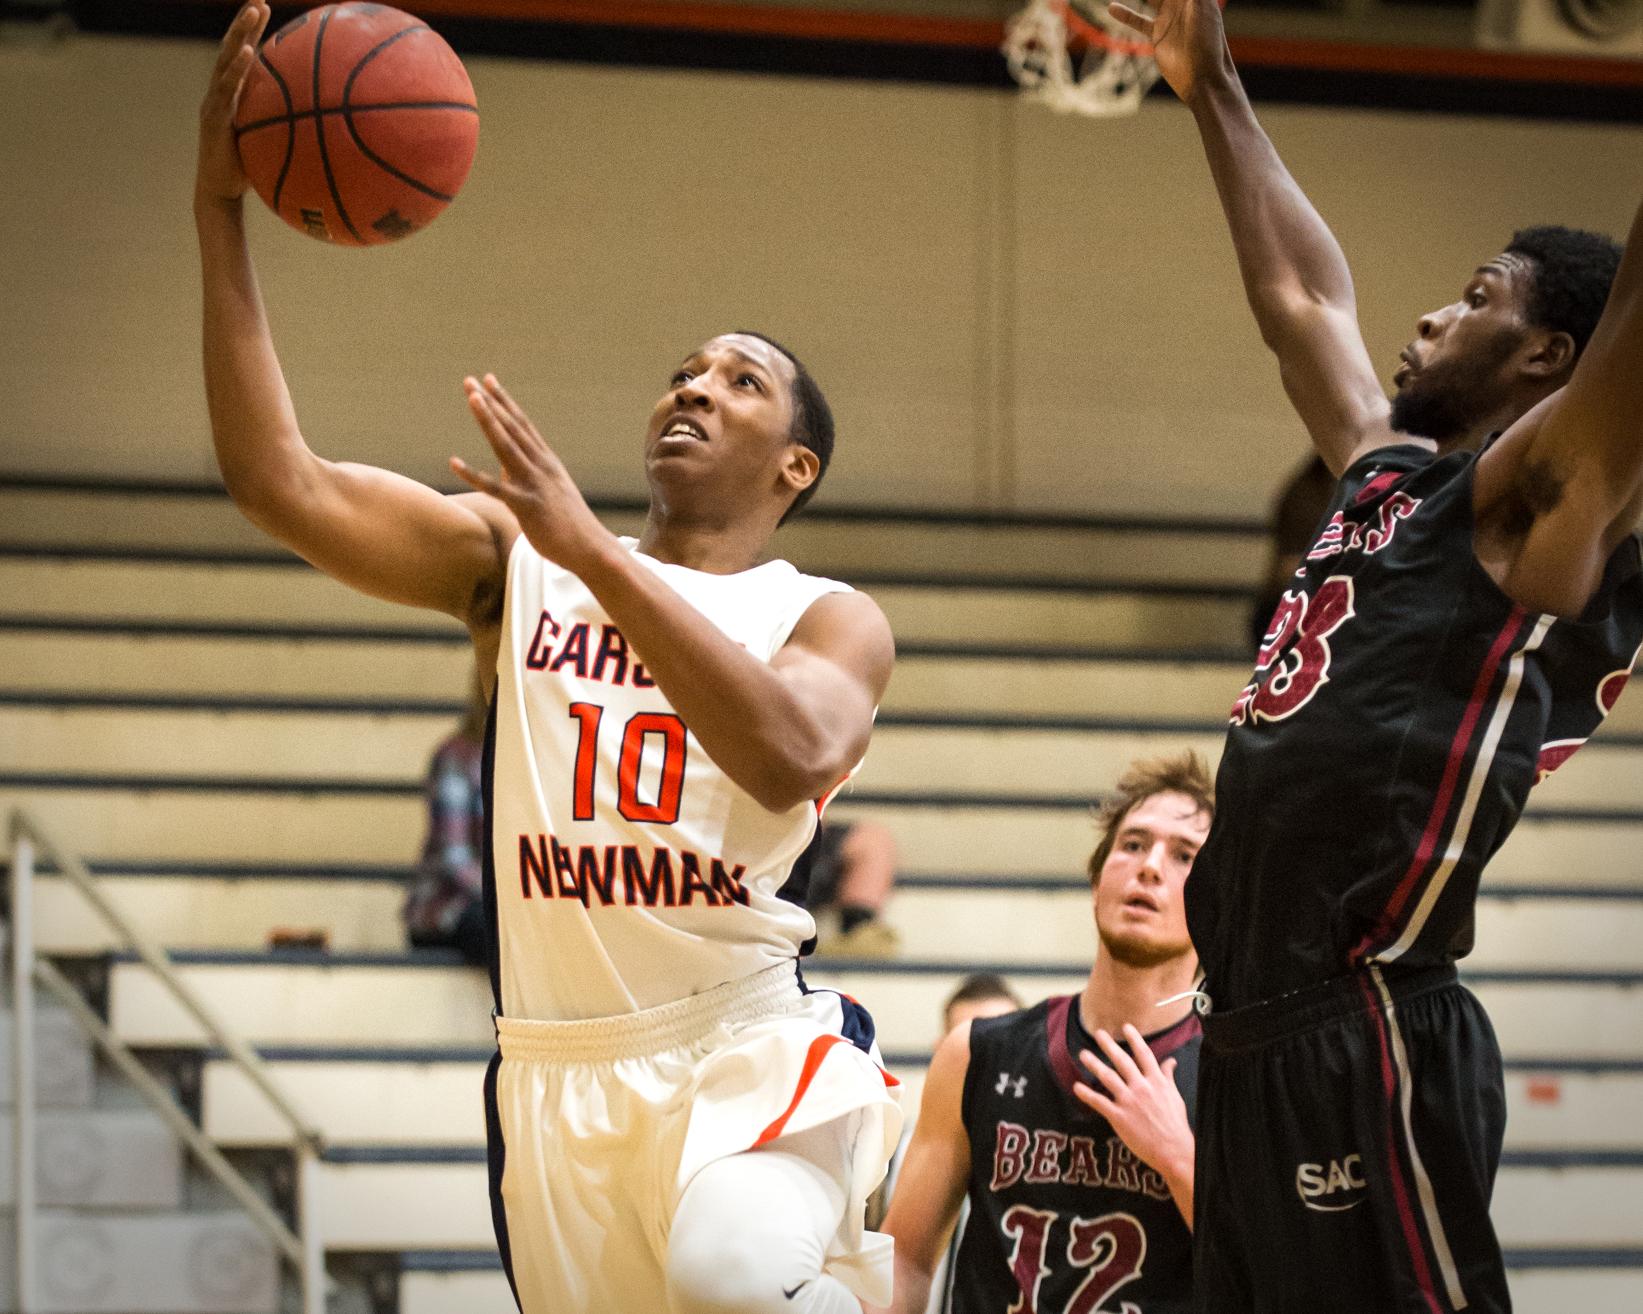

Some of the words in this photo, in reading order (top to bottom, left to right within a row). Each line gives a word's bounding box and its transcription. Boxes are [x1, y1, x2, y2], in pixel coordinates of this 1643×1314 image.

[569, 701, 687, 826] 10
[518, 833, 751, 909] NEWMAN
[1296, 1153, 1367, 1197] SAC
[1001, 1204, 1147, 1314] 12
